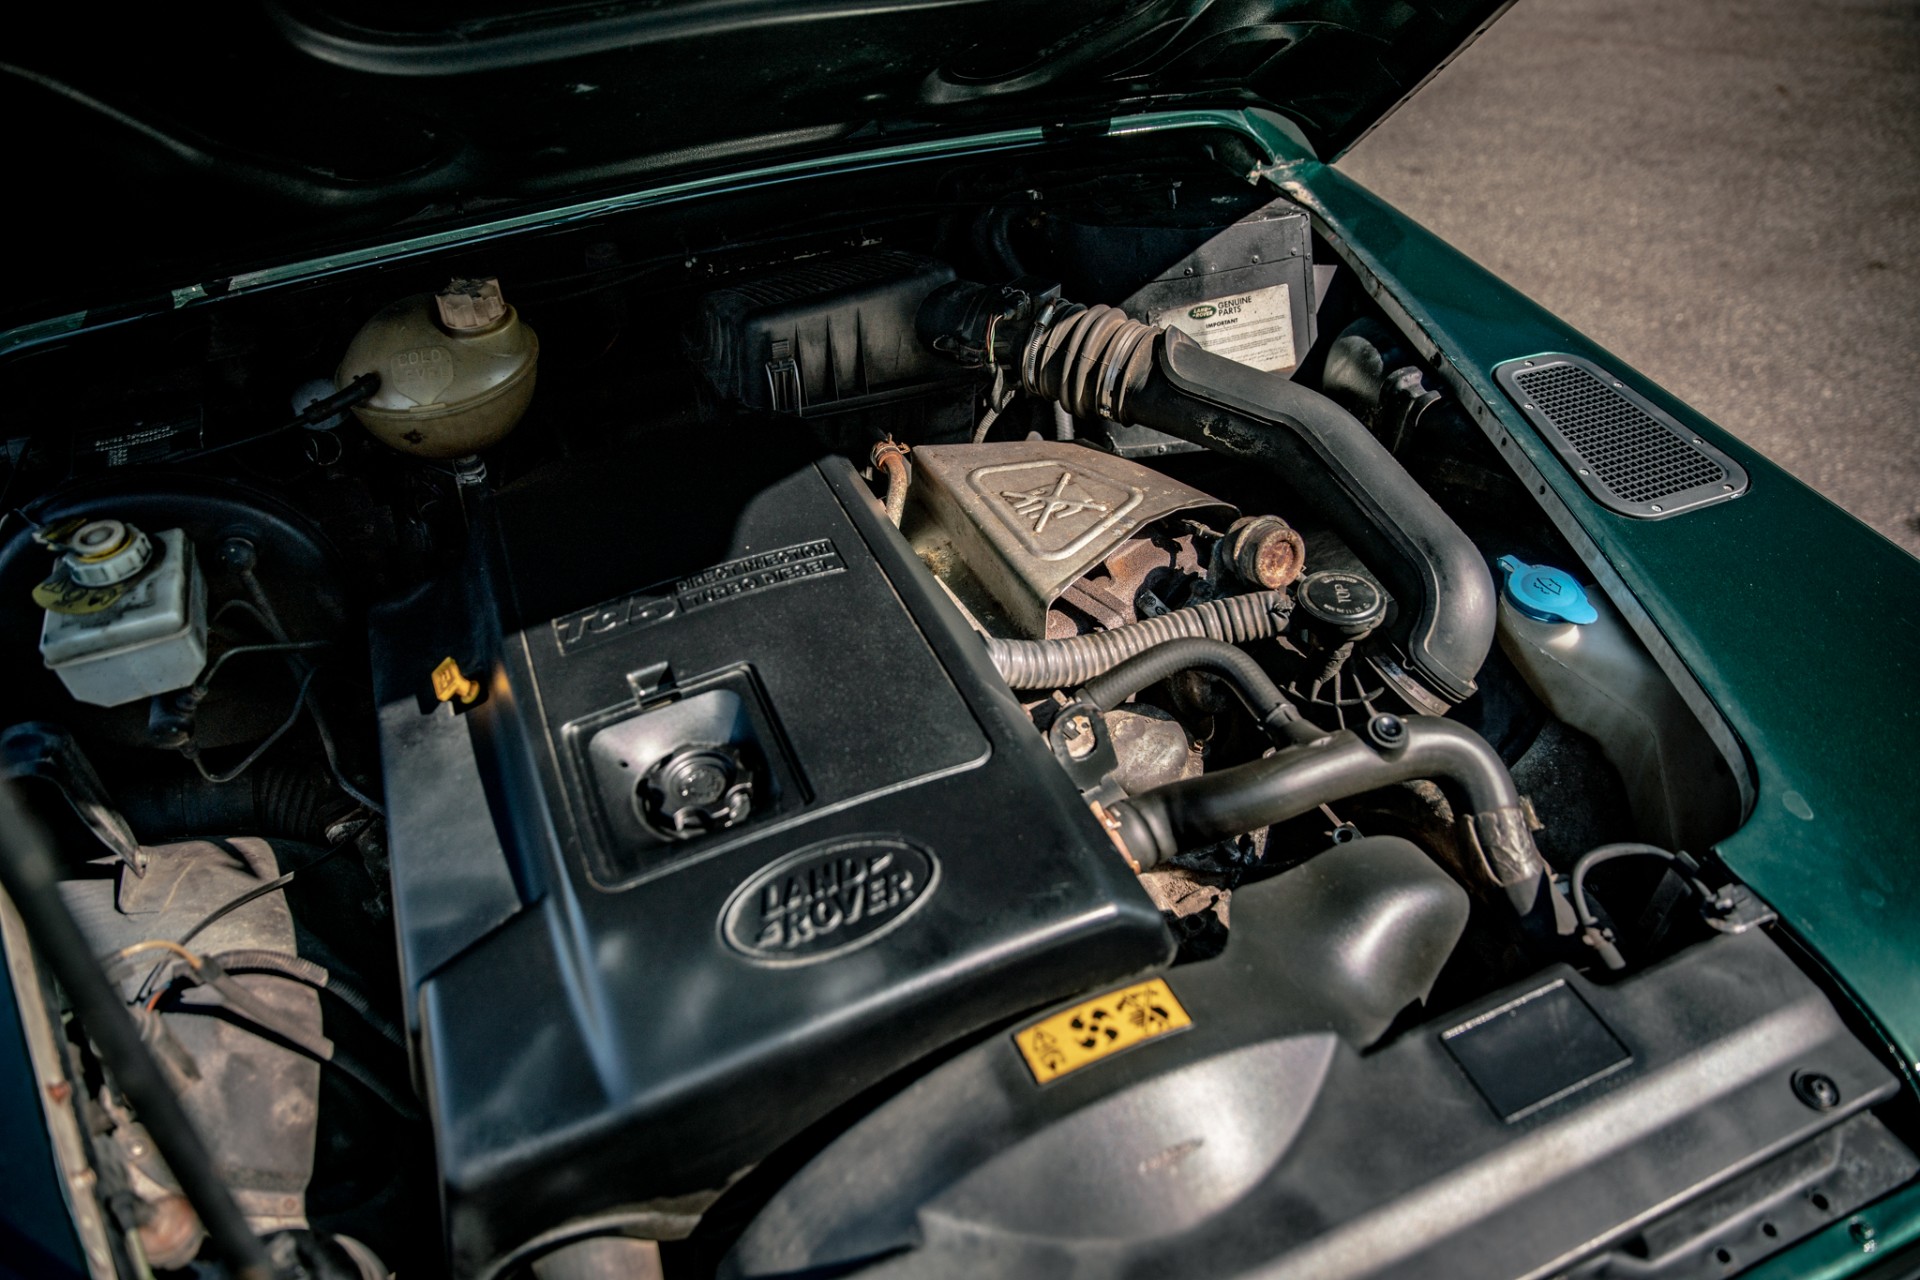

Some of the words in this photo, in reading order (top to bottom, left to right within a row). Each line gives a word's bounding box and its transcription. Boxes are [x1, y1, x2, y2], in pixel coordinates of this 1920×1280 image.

[1217, 296, 1252, 309] GENUINE
[1218, 306, 1242, 316] PARTS
[1205, 318, 1239, 328] IMPORTANT
[398, 349, 442, 366] COLD
[676, 565, 738, 593] DIRECT
[740, 543, 830, 573] INJECTION
[686, 577, 759, 606] TURBO
[761, 559, 835, 585] DIESEL
[1334, 583, 1353, 604] TOP
[760, 856, 870, 920] LAND
[782, 868, 916, 949] ROVER
